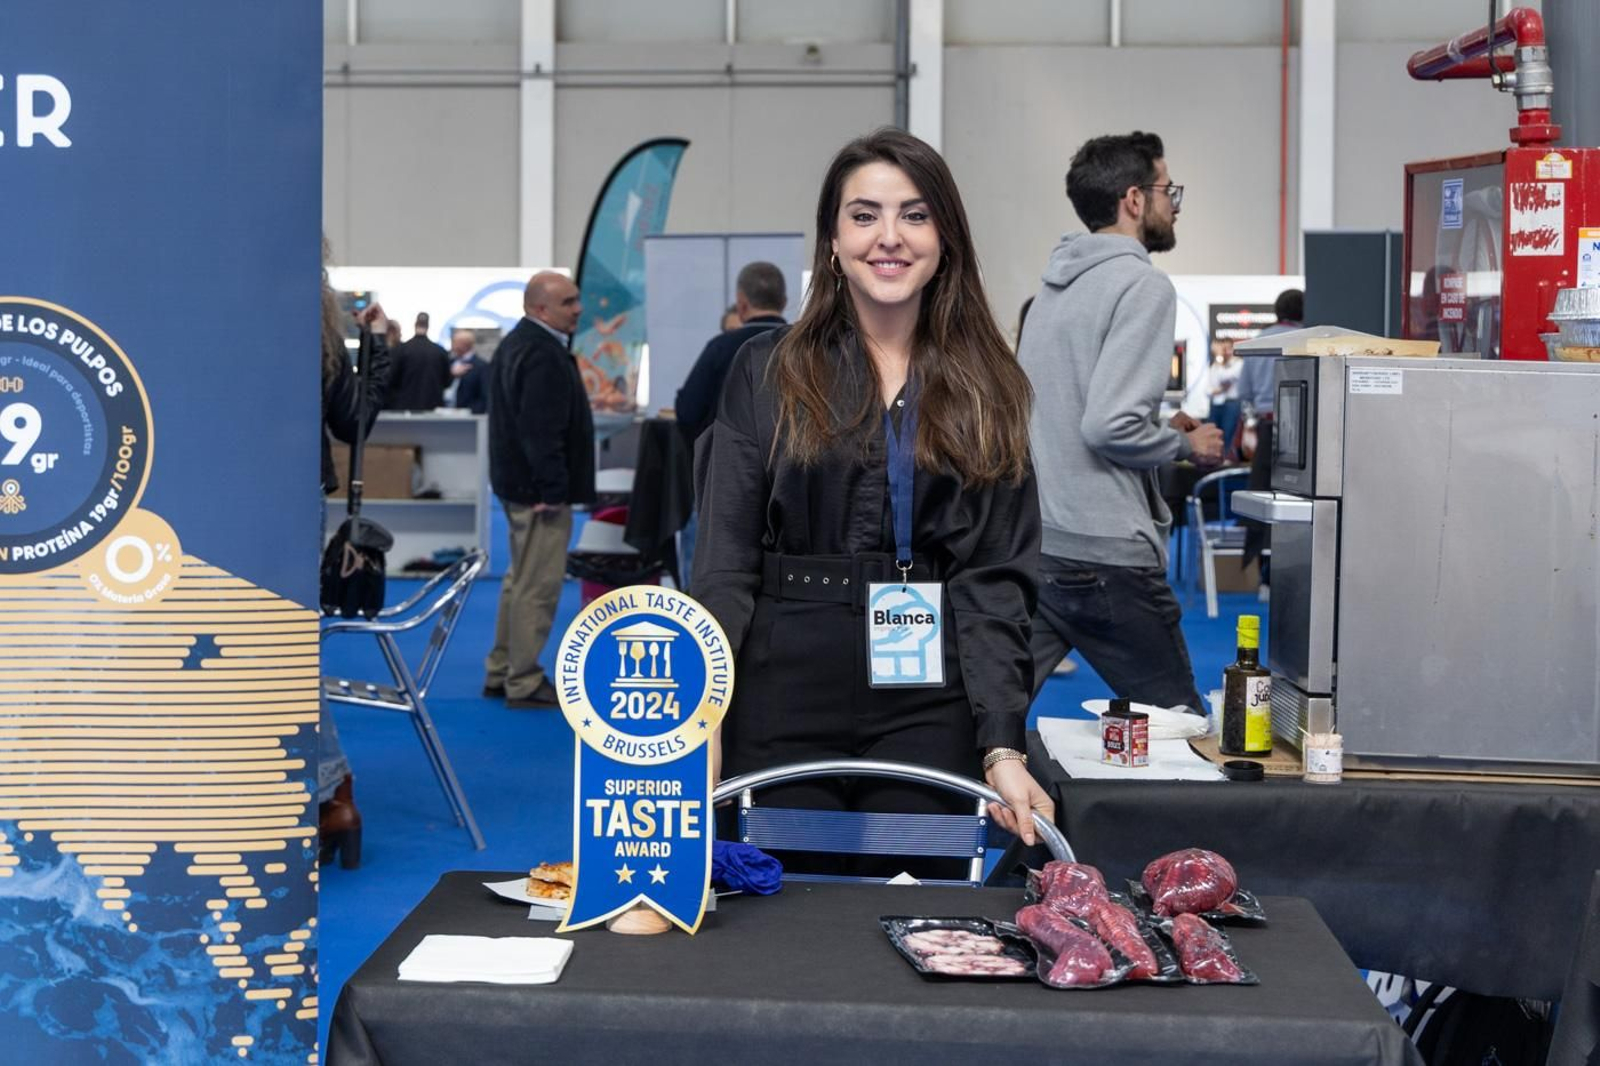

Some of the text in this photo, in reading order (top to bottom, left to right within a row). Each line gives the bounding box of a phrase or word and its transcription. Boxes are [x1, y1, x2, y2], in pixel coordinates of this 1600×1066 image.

[0, 74, 72, 148] R
[18, 315, 59, 340] LOS
[59, 329, 123, 397] PULPOS
[22, 356, 51, 374] Ideal
[48, 369, 74, 392] para
[71, 391, 94, 456] deportistas
[12, 521, 95, 562] PROTEÍNA
[874, 609, 935, 625] Blanca
[563, 592, 728, 708] INTERNATIONAL TASTE INSTITUTE
[610, 690, 680, 720] 2024
[603, 733, 687, 758] BRUSSELS
[604, 779, 682, 796] SUPERIOR
[585, 798, 701, 838] TASTE
[614, 841, 672, 858] AWARD
